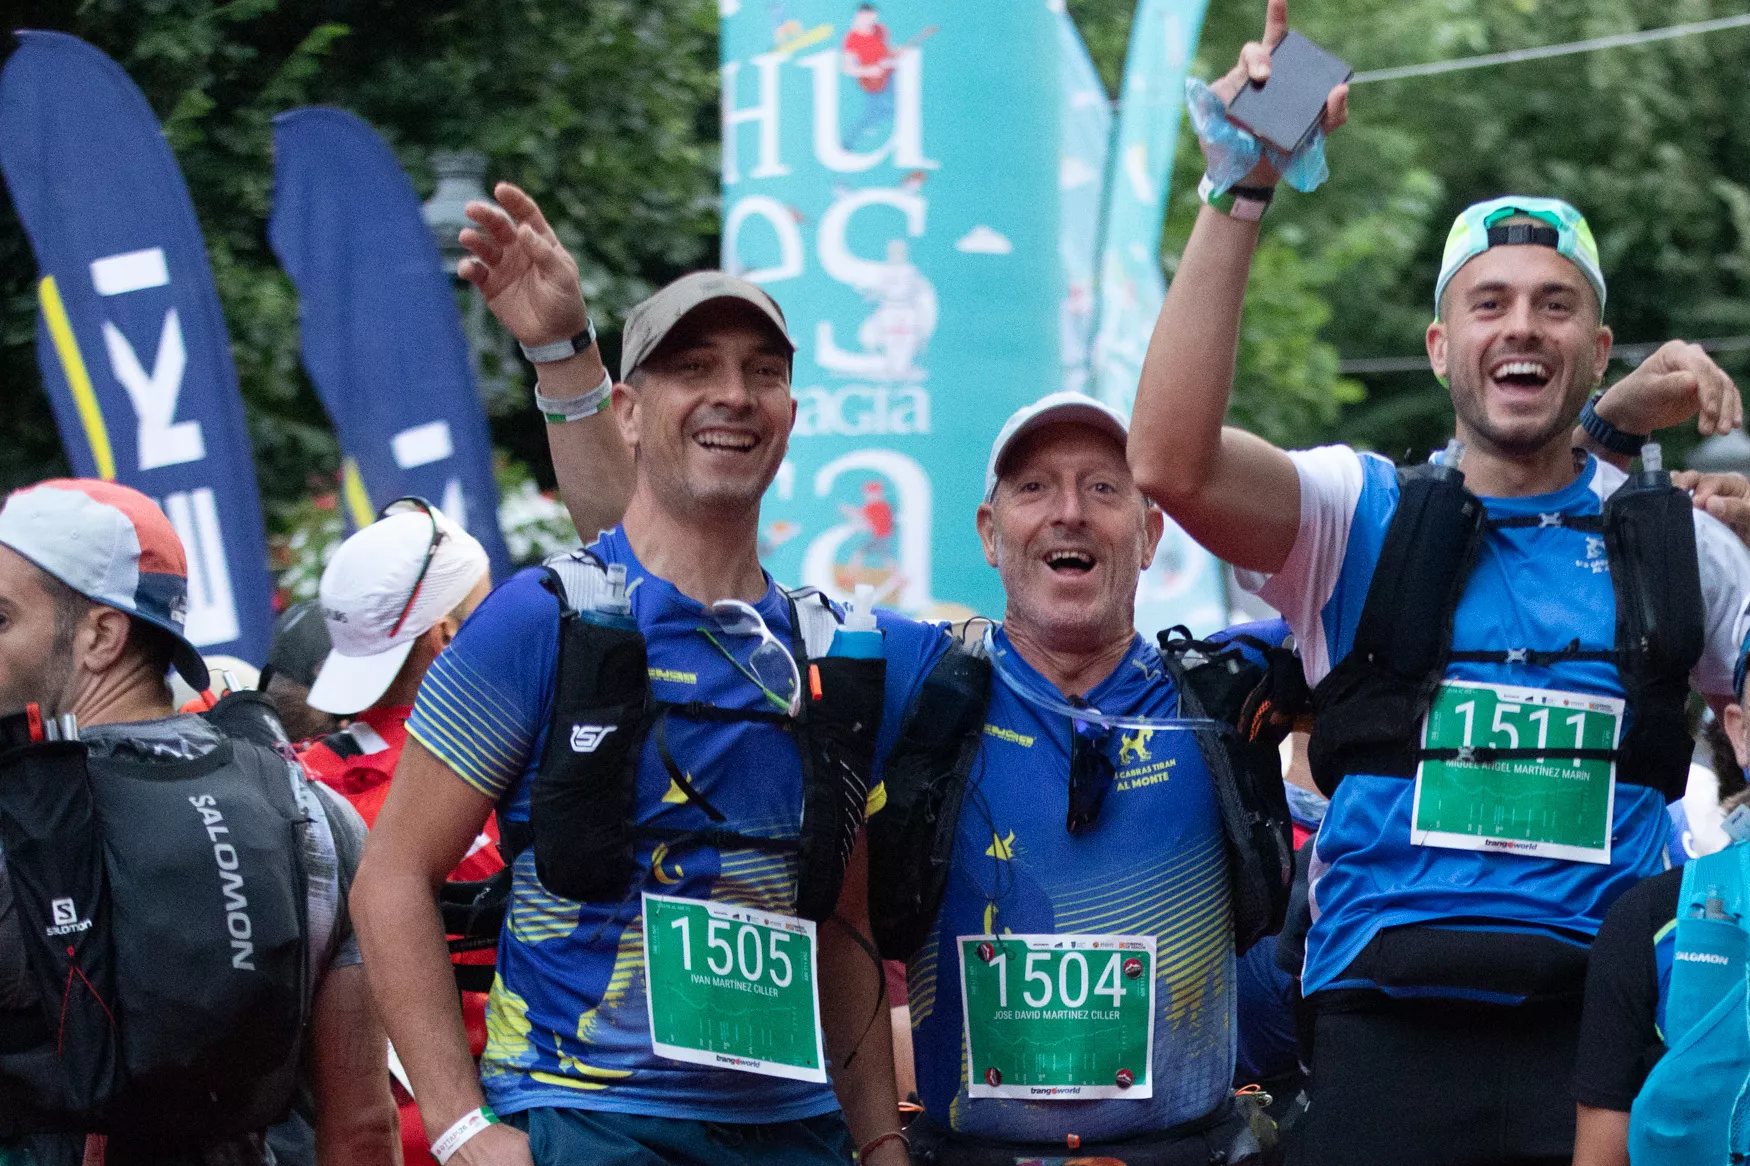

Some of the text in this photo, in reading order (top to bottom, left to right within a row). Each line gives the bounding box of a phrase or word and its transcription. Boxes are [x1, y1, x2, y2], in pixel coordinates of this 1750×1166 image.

[1455, 700, 1586, 768] 1511
[1116, 772, 1169, 792] AL MONTE
[1119, 766, 1152, 779] CABRAS
[188, 794, 256, 971] SALOMON
[671, 916, 793, 988] 1505
[691, 974, 711, 985] IVAN
[753, 985, 779, 997] CILLER
[989, 952, 1127, 1008] 1504
[993, 1010, 1120, 1020] JOSE DAVID MARTINEZ CILLER
